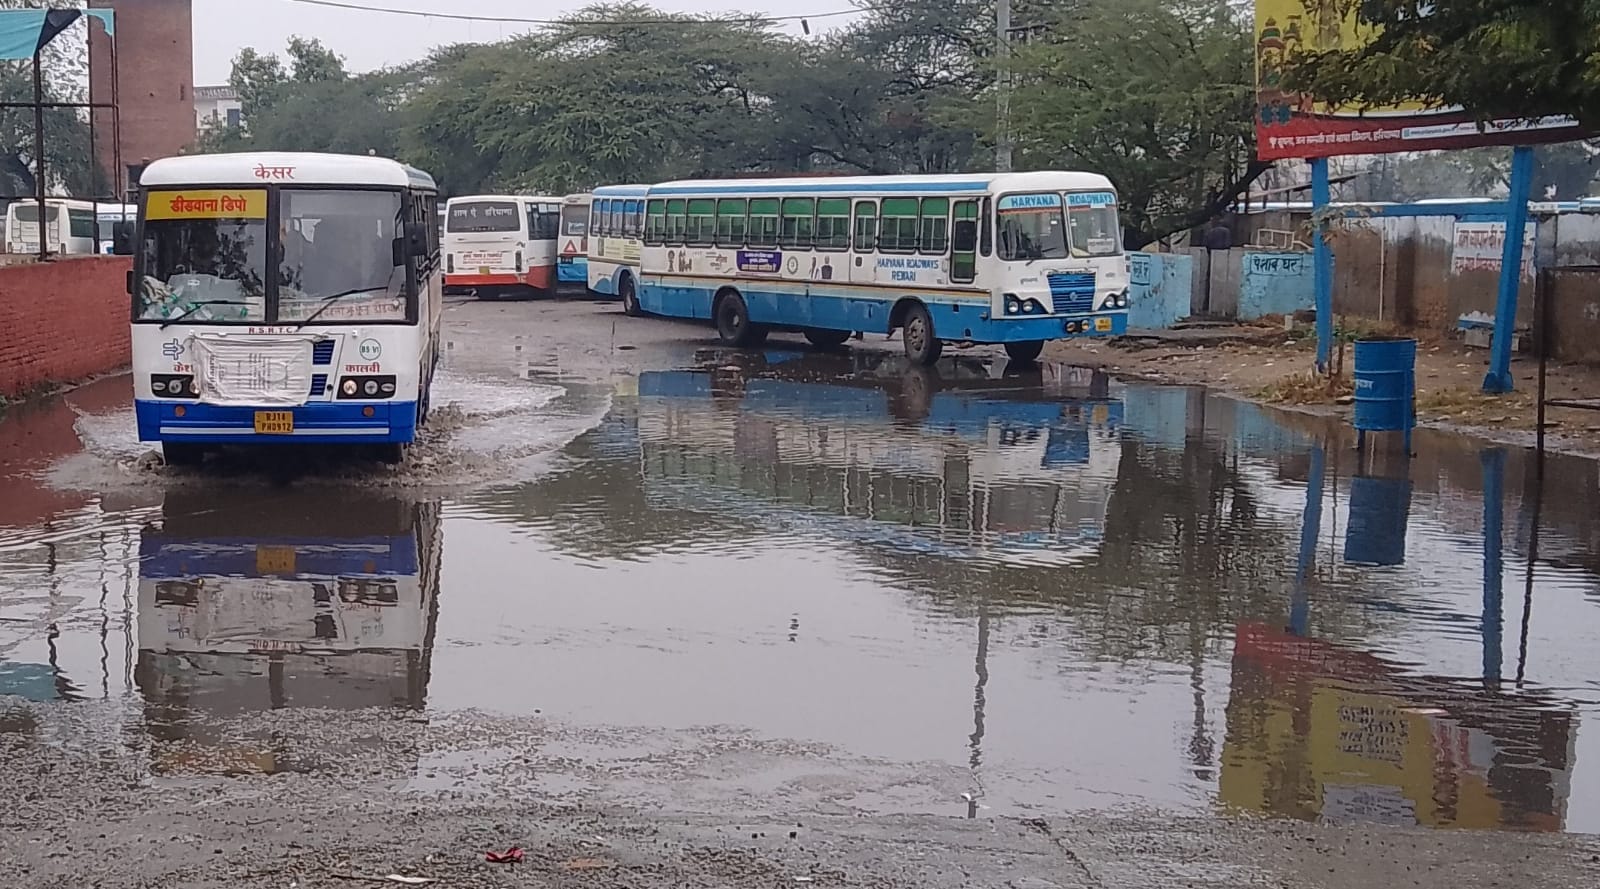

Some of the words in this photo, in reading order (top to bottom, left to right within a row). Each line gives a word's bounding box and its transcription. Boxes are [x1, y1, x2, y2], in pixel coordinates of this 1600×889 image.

[253, 163, 296, 179] केसर
[170, 194, 218, 213] डीडवाना
[221, 194, 247, 212] डिपो
[1011, 195, 1055, 207] HARYANA
[1070, 194, 1113, 205] ROADWAYS
[877, 258, 905, 268] HARYANA
[907, 259, 939, 269] ROADWAYS
[892, 271, 916, 281] REWARI
[266, 412, 286, 421] RJ14
